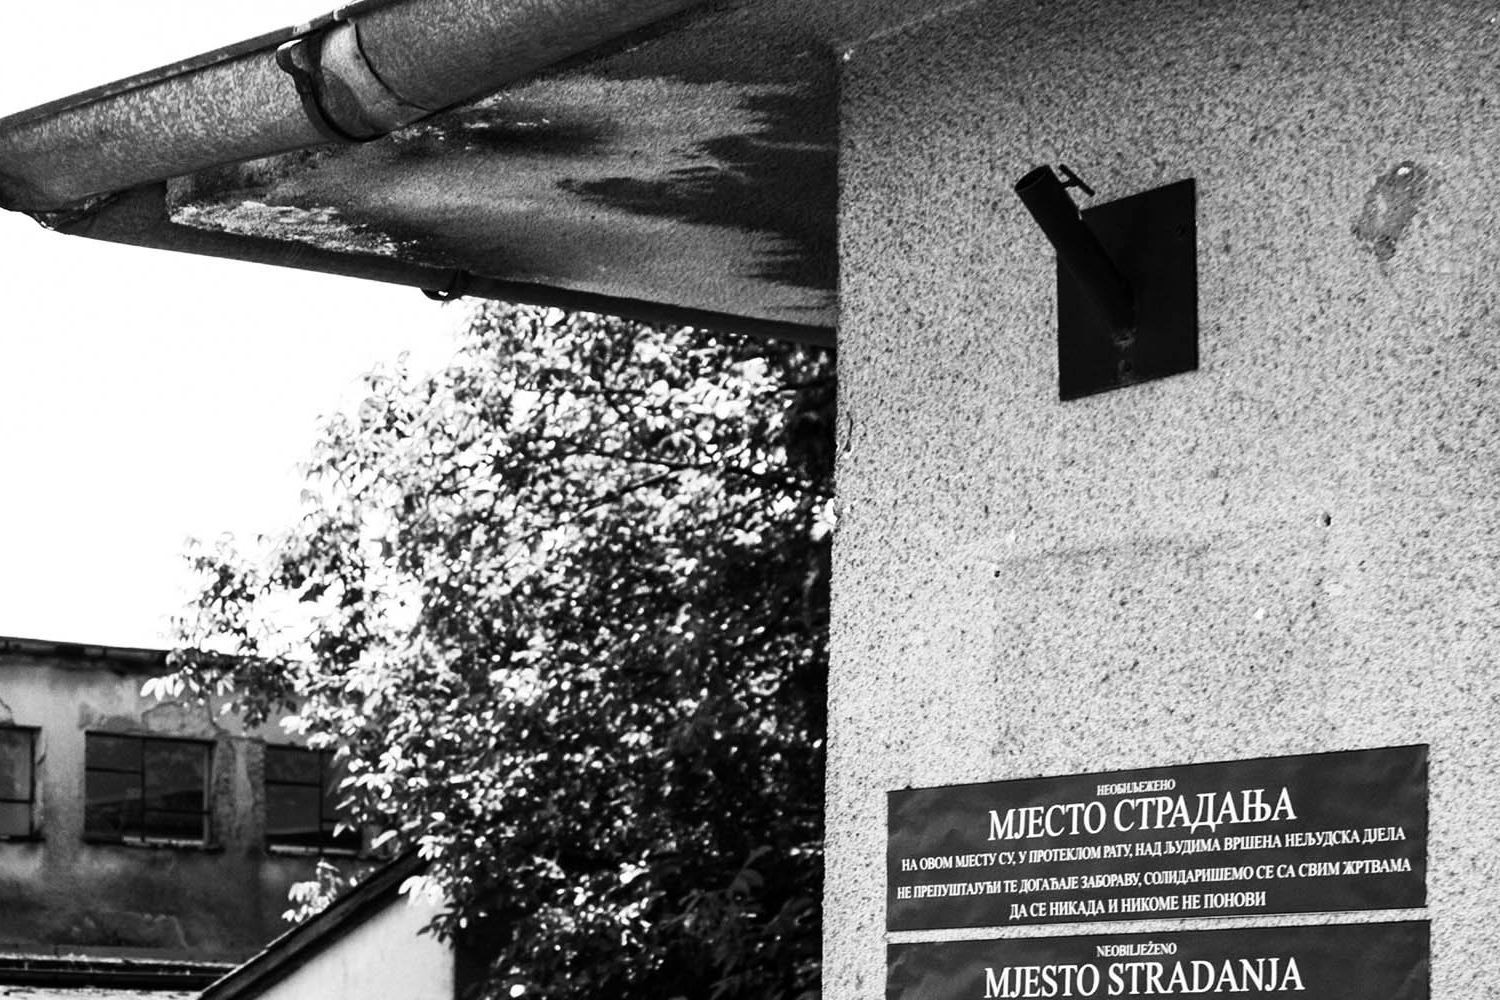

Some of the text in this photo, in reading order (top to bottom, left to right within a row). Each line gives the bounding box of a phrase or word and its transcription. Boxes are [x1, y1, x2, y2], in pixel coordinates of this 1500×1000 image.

[1097, 779, 1176, 795] НЕОБИЉЕЖЕНО
[988, 787, 1297, 841] МЈЕСТО СТРАДАЊА
[902, 858, 918, 871] НА
[919, 856, 953, 870] ОВОМ
[955, 853, 998, 868] МЈЕСТУ
[1018, 851, 1028, 864] У
[1029, 845, 1101, 863] ПРОТЕКЛОМ
[1135, 842, 1162, 857] НАД
[1164, 839, 1220, 856] ЉУДИМА
[1224, 834, 1282, 851] ВРШЕНА
[1285, 829, 1360, 847] НЕЉУДСКА
[1362, 827, 1406, 844] ДЈЕЛА
[897, 886, 912, 899] НЕ
[1003, 880, 1018, 893] ТЕ
[1144, 866, 1254, 886] СОЛИДАРИШЕМО
[1256, 865, 1274, 879] СЕ
[1277, 864, 1296, 878] СА
[1298, 862, 1340, 877] СВИМ
[1342, 858, 1412, 875] ЖРТВАМА
[1009, 891, 1266, 920] ДА СЕ НИКАДА И НИКОМЕ НЕ ПОНОВИ
[1096, 941, 1177, 957] NEOBILJEŽENO
[984, 957, 1306, 998] MJESTO STRADANJA
